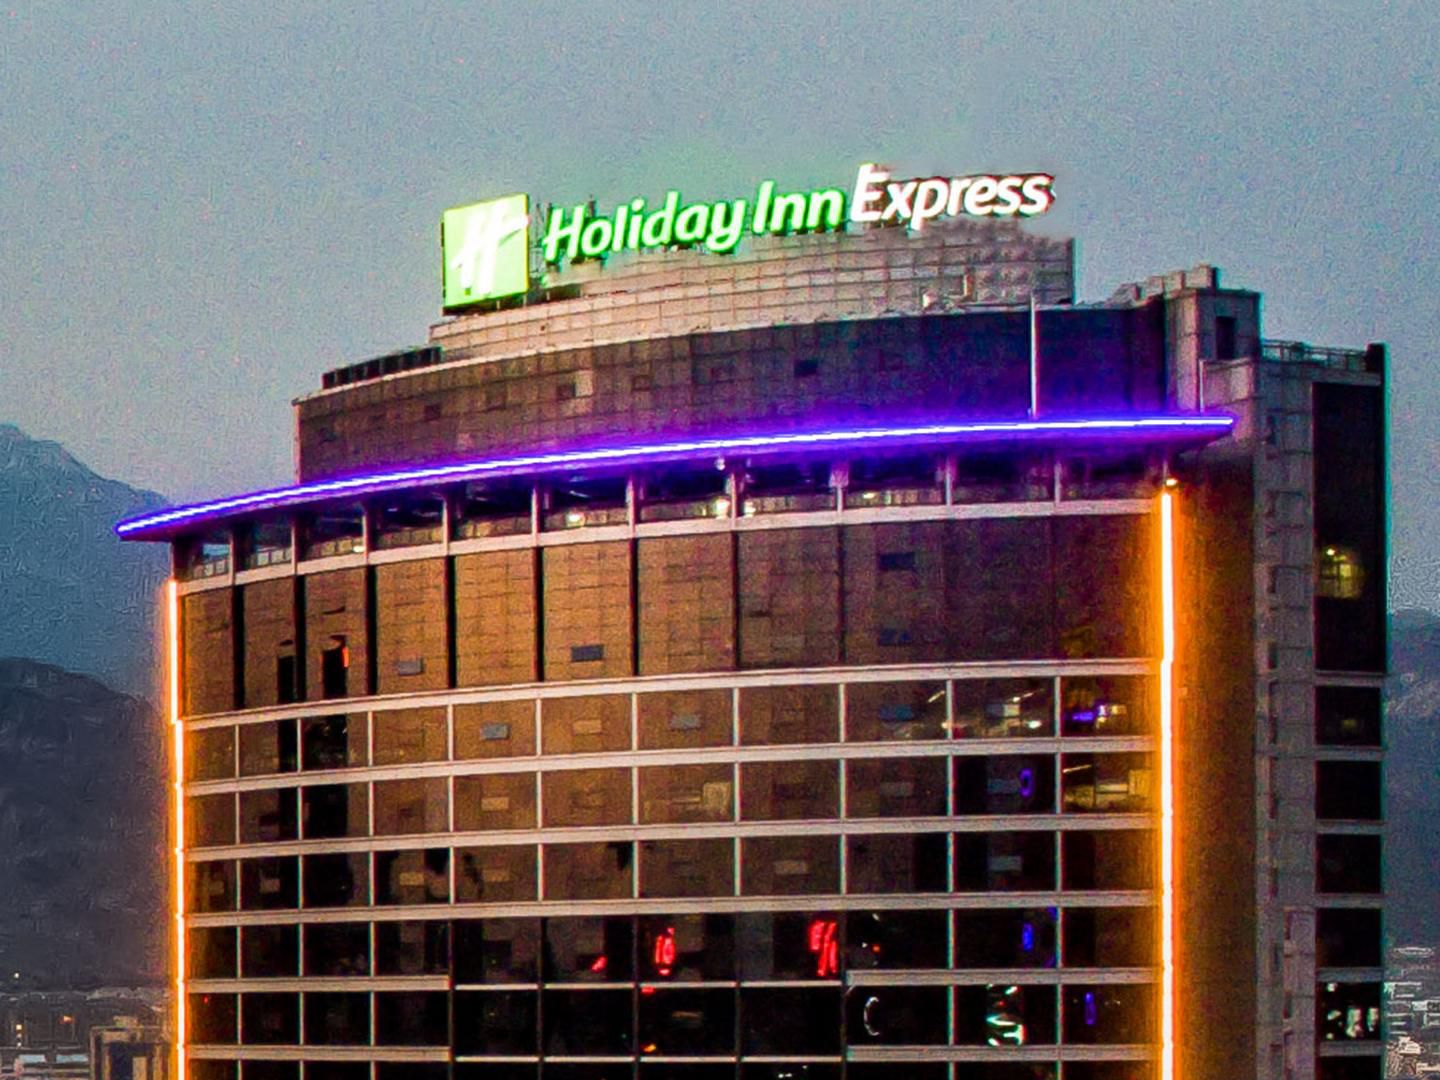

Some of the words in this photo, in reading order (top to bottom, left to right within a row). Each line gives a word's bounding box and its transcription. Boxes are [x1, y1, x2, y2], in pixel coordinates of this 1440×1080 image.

[542, 190, 748, 263] Holiday
[752, 179, 845, 236] Inn
[849, 162, 1054, 231] Express
